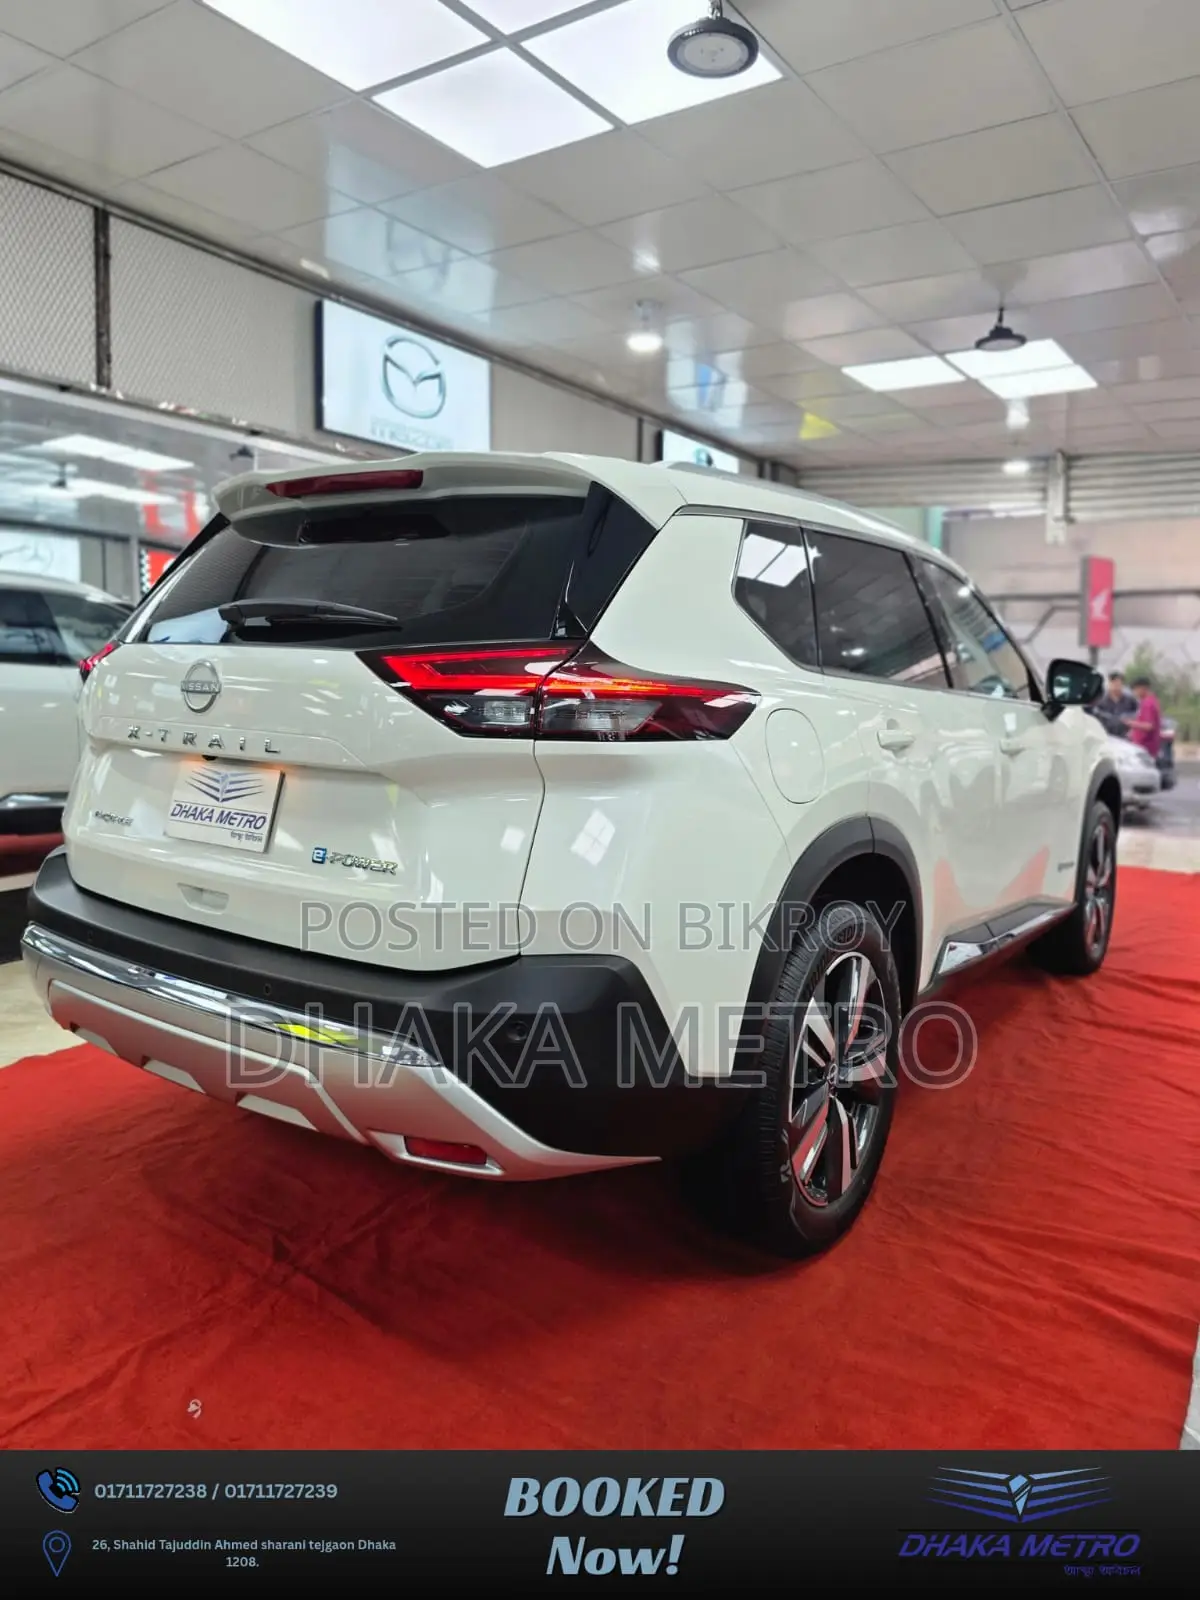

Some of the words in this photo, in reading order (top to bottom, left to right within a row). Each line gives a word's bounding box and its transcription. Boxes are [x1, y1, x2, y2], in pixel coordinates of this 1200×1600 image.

[181, 681, 220, 692] NISSAN
[127, 724, 281, 754] X-TRAIL
[170, 803, 215, 822] DHAKA
[216, 810, 268, 831] METRO
